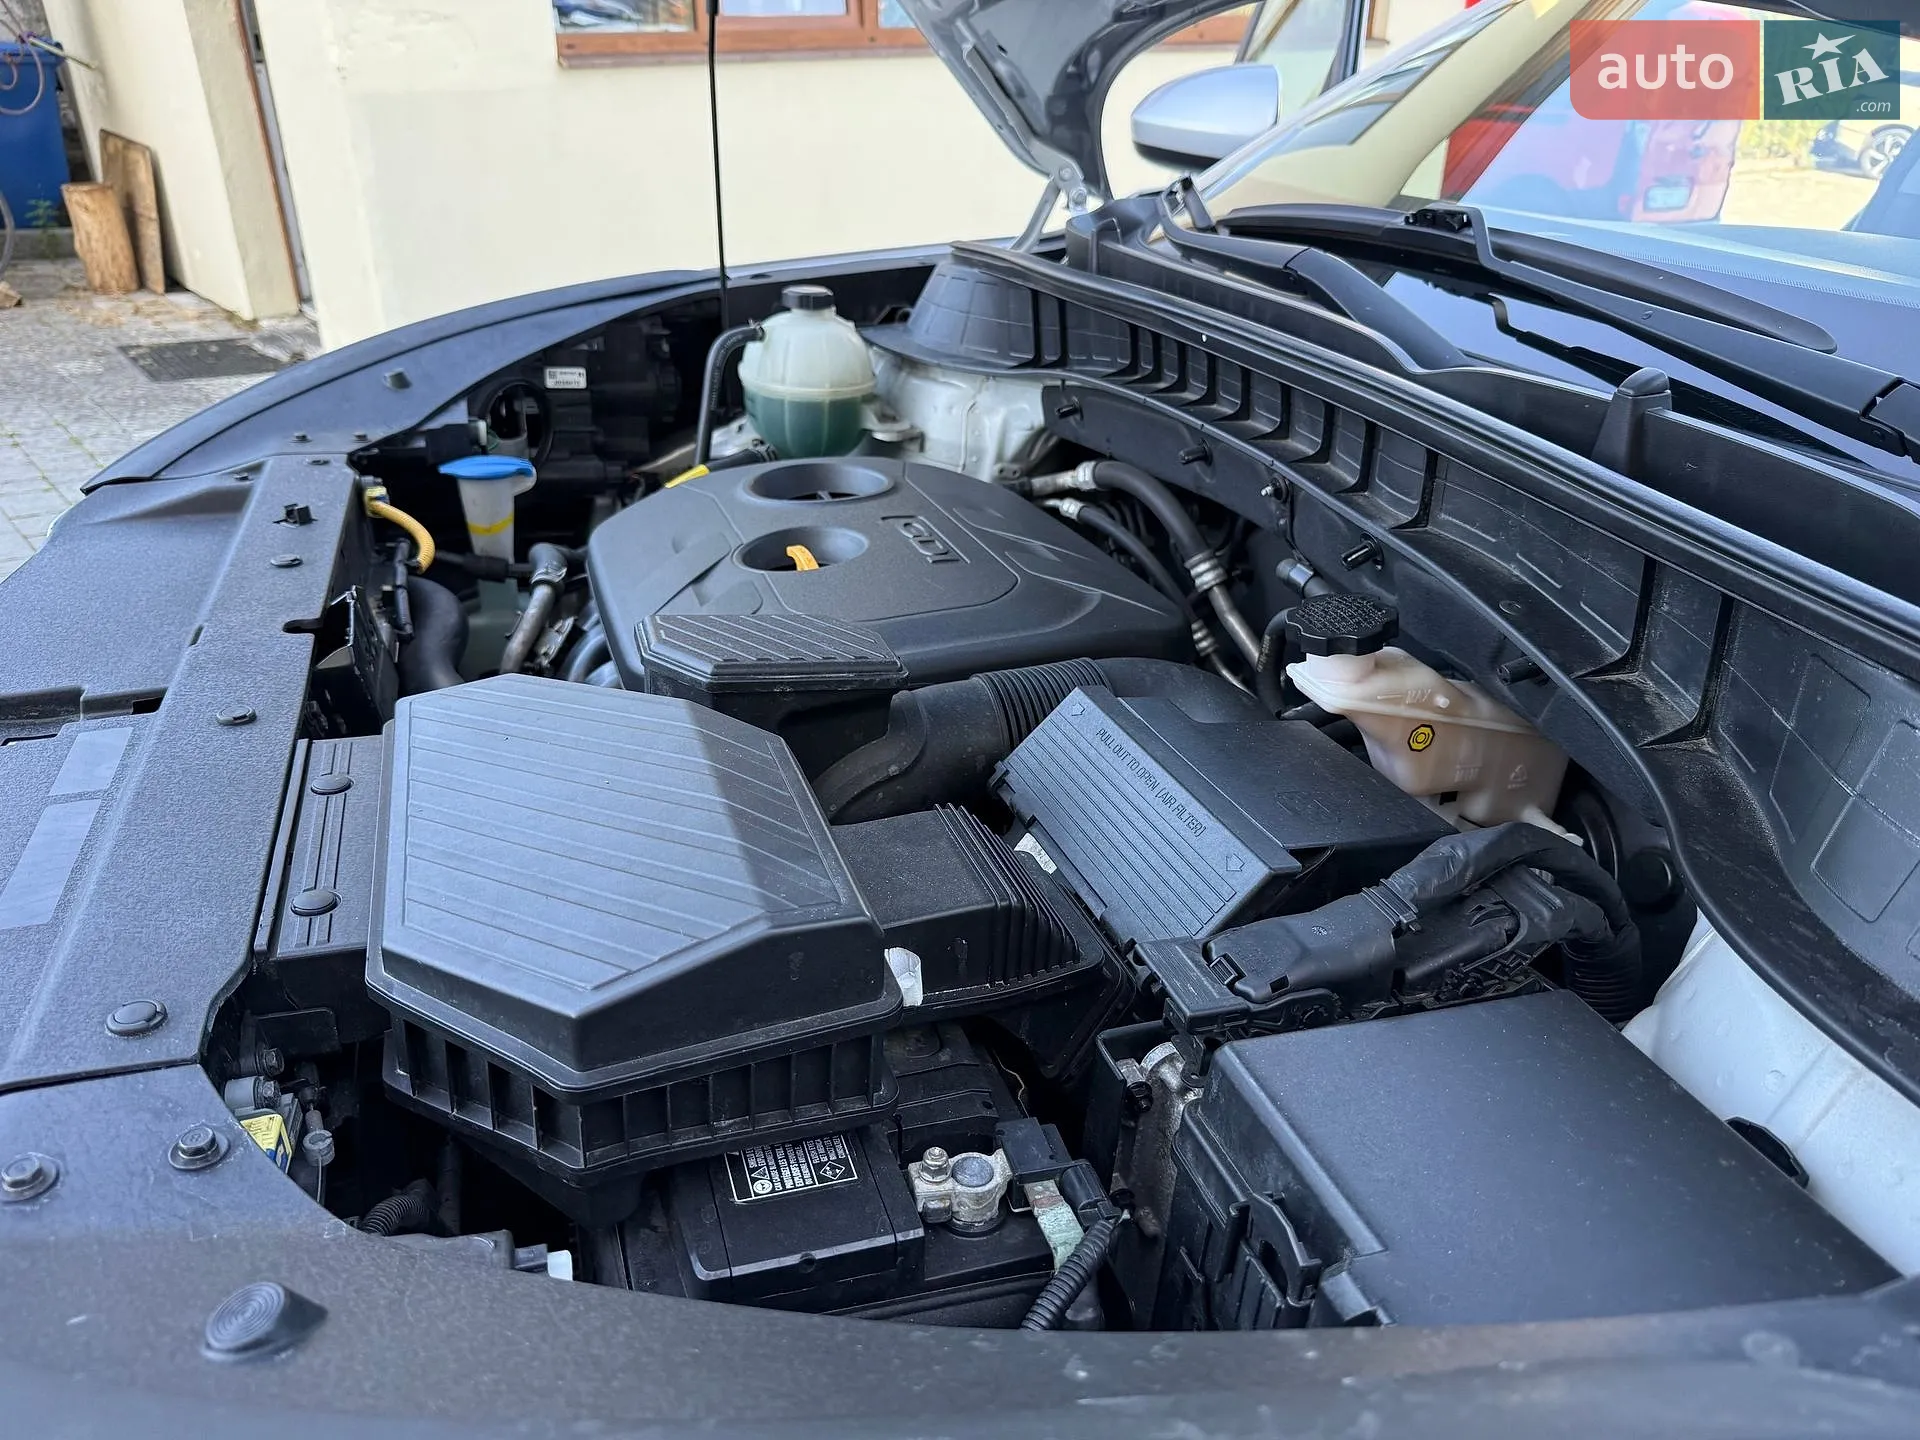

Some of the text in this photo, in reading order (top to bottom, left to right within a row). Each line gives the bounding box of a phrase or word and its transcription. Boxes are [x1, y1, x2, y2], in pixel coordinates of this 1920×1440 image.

[1095, 728, 1114, 748] PULL
[1112, 744, 1131, 762] OUT
[1127, 755, 1139, 771] TO
[1136, 766, 1160, 792] OPEN
